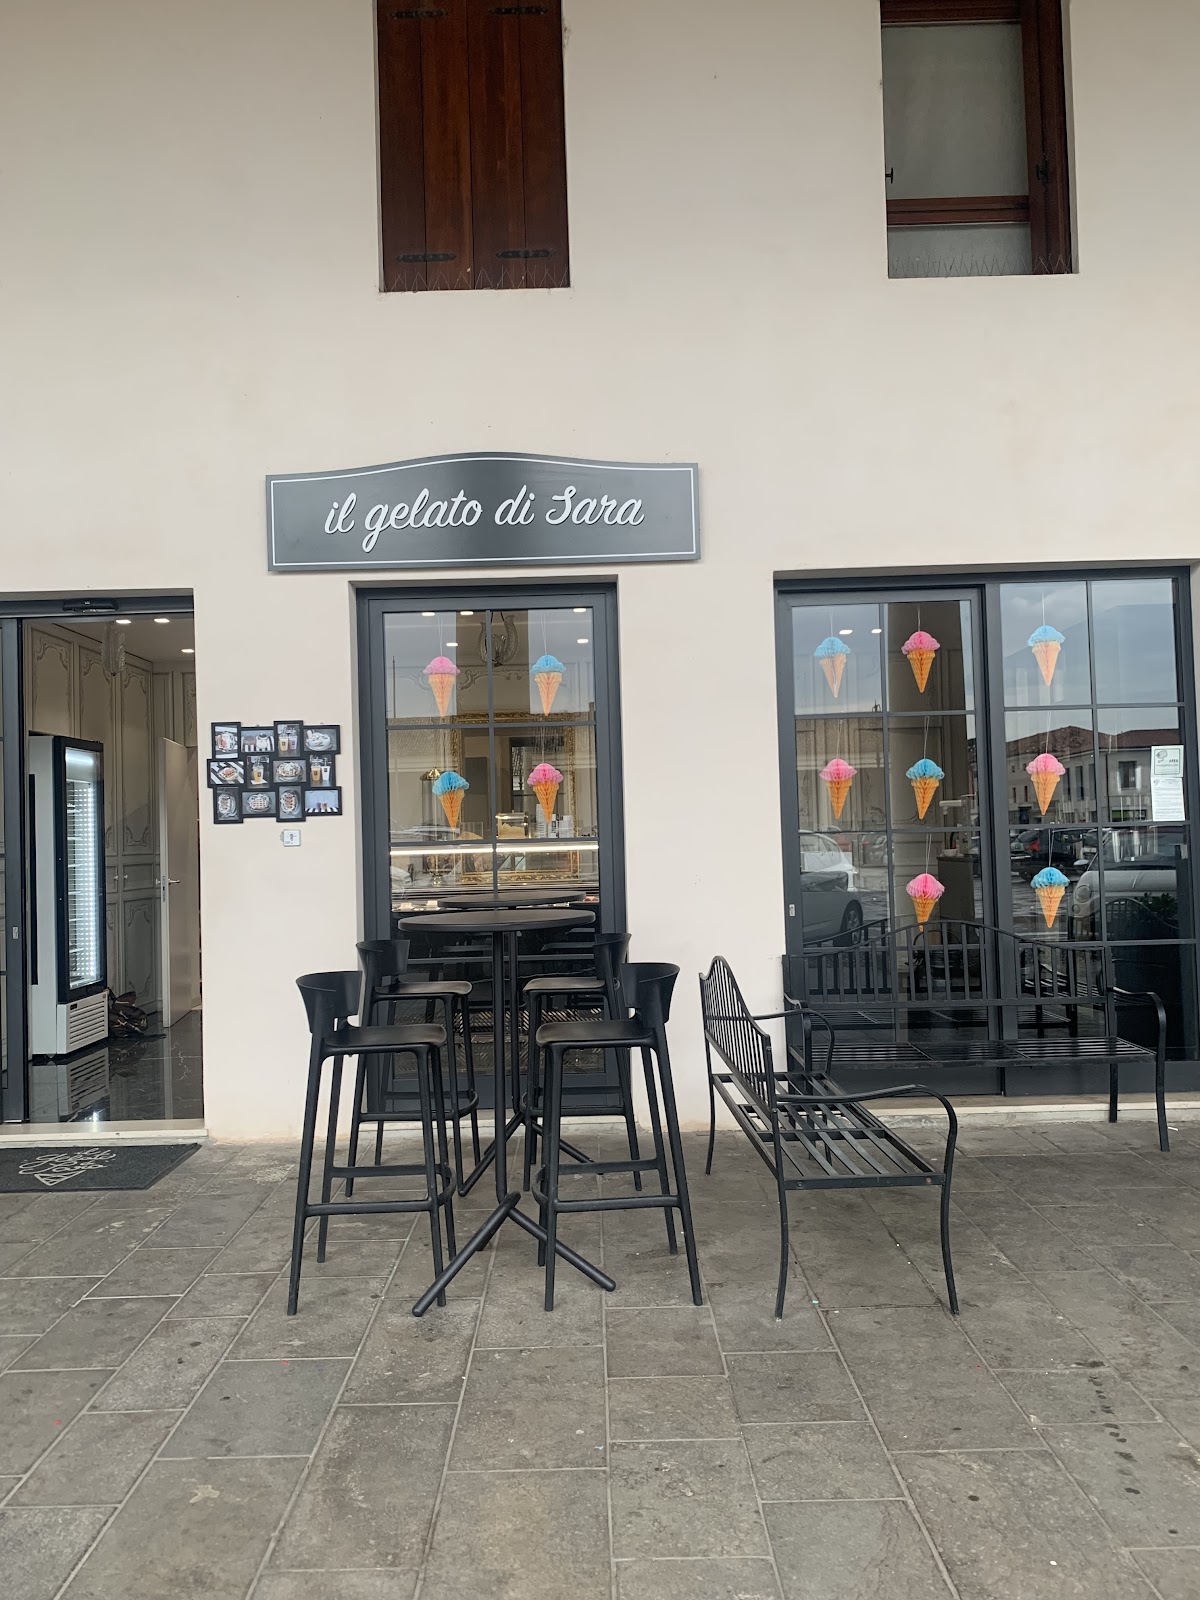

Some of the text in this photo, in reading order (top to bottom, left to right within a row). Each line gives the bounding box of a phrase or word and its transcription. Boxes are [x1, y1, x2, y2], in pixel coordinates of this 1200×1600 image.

[324, 484, 645, 553] il gelato di Sara
